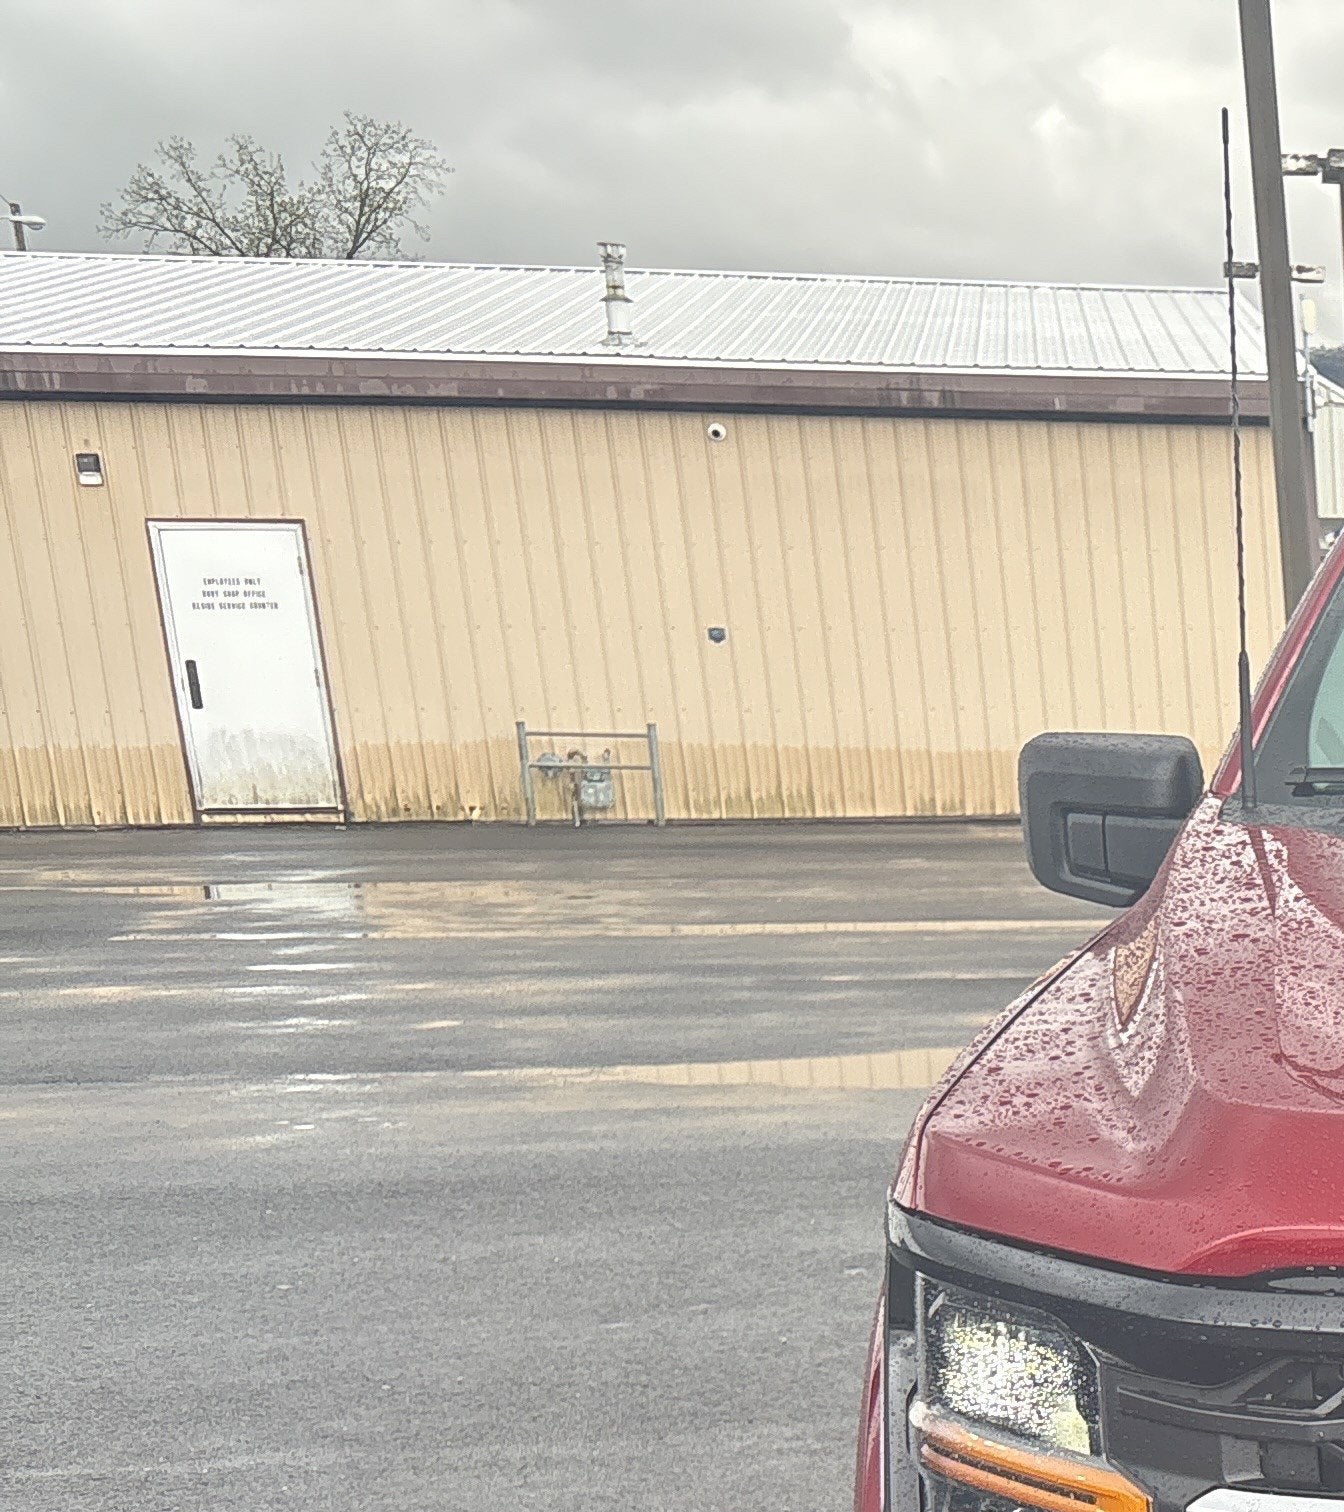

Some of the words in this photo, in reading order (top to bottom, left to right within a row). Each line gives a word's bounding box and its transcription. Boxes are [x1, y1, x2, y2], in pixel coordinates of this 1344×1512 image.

[244, 578, 261, 586] ONLY
[223, 590, 240, 598] SHOP
[243, 590, 266, 598] OFFICE
[219, 602, 246, 610] SERVICE
[249, 602, 279, 610] COUNTER
